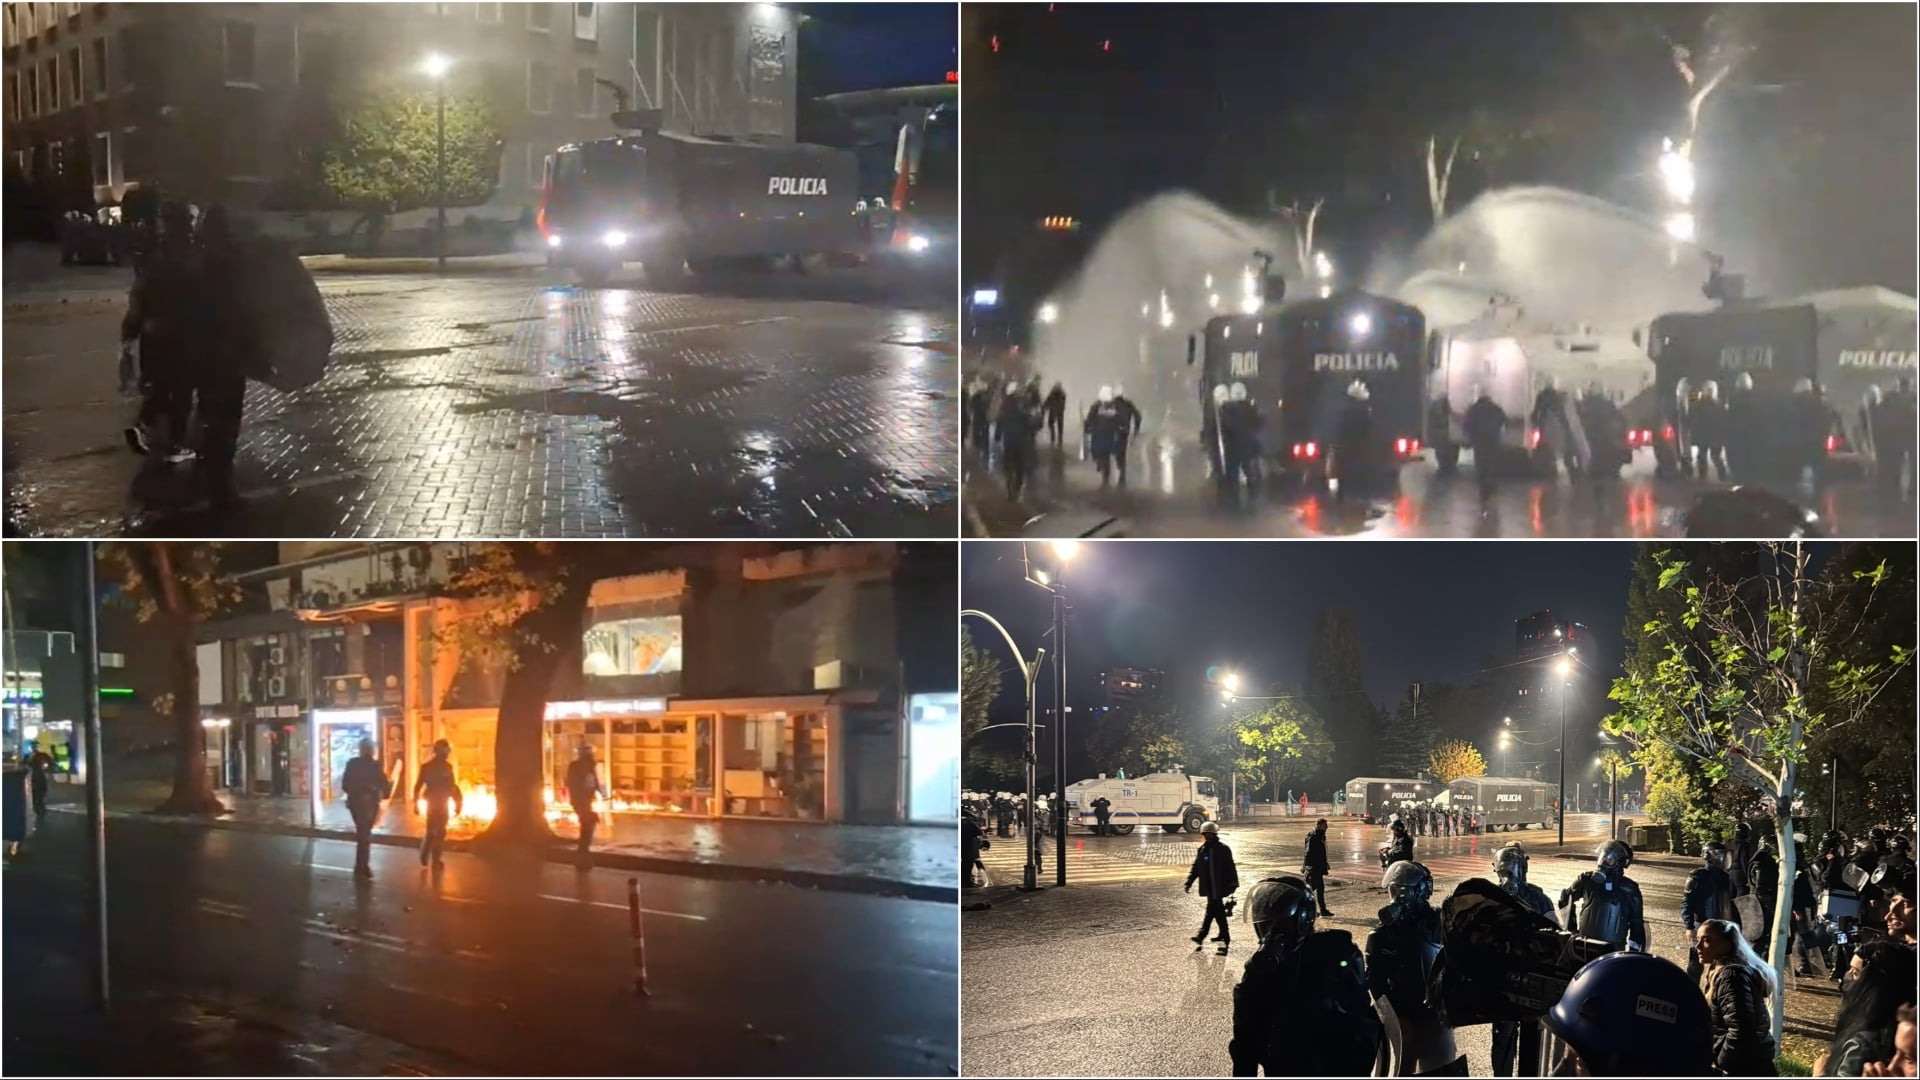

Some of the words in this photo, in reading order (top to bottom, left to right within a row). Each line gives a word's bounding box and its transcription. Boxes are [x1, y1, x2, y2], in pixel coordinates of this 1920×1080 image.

[768, 177, 828, 195] POLICIA
[1314, 352, 1399, 371] POLICIA
[1838, 350, 1918, 368] POLICIA
[1121, 789, 1138, 797] TR-1
[1496, 794, 1522, 802] POLICIA
[1638, 999, 1676, 1018] PRESS
